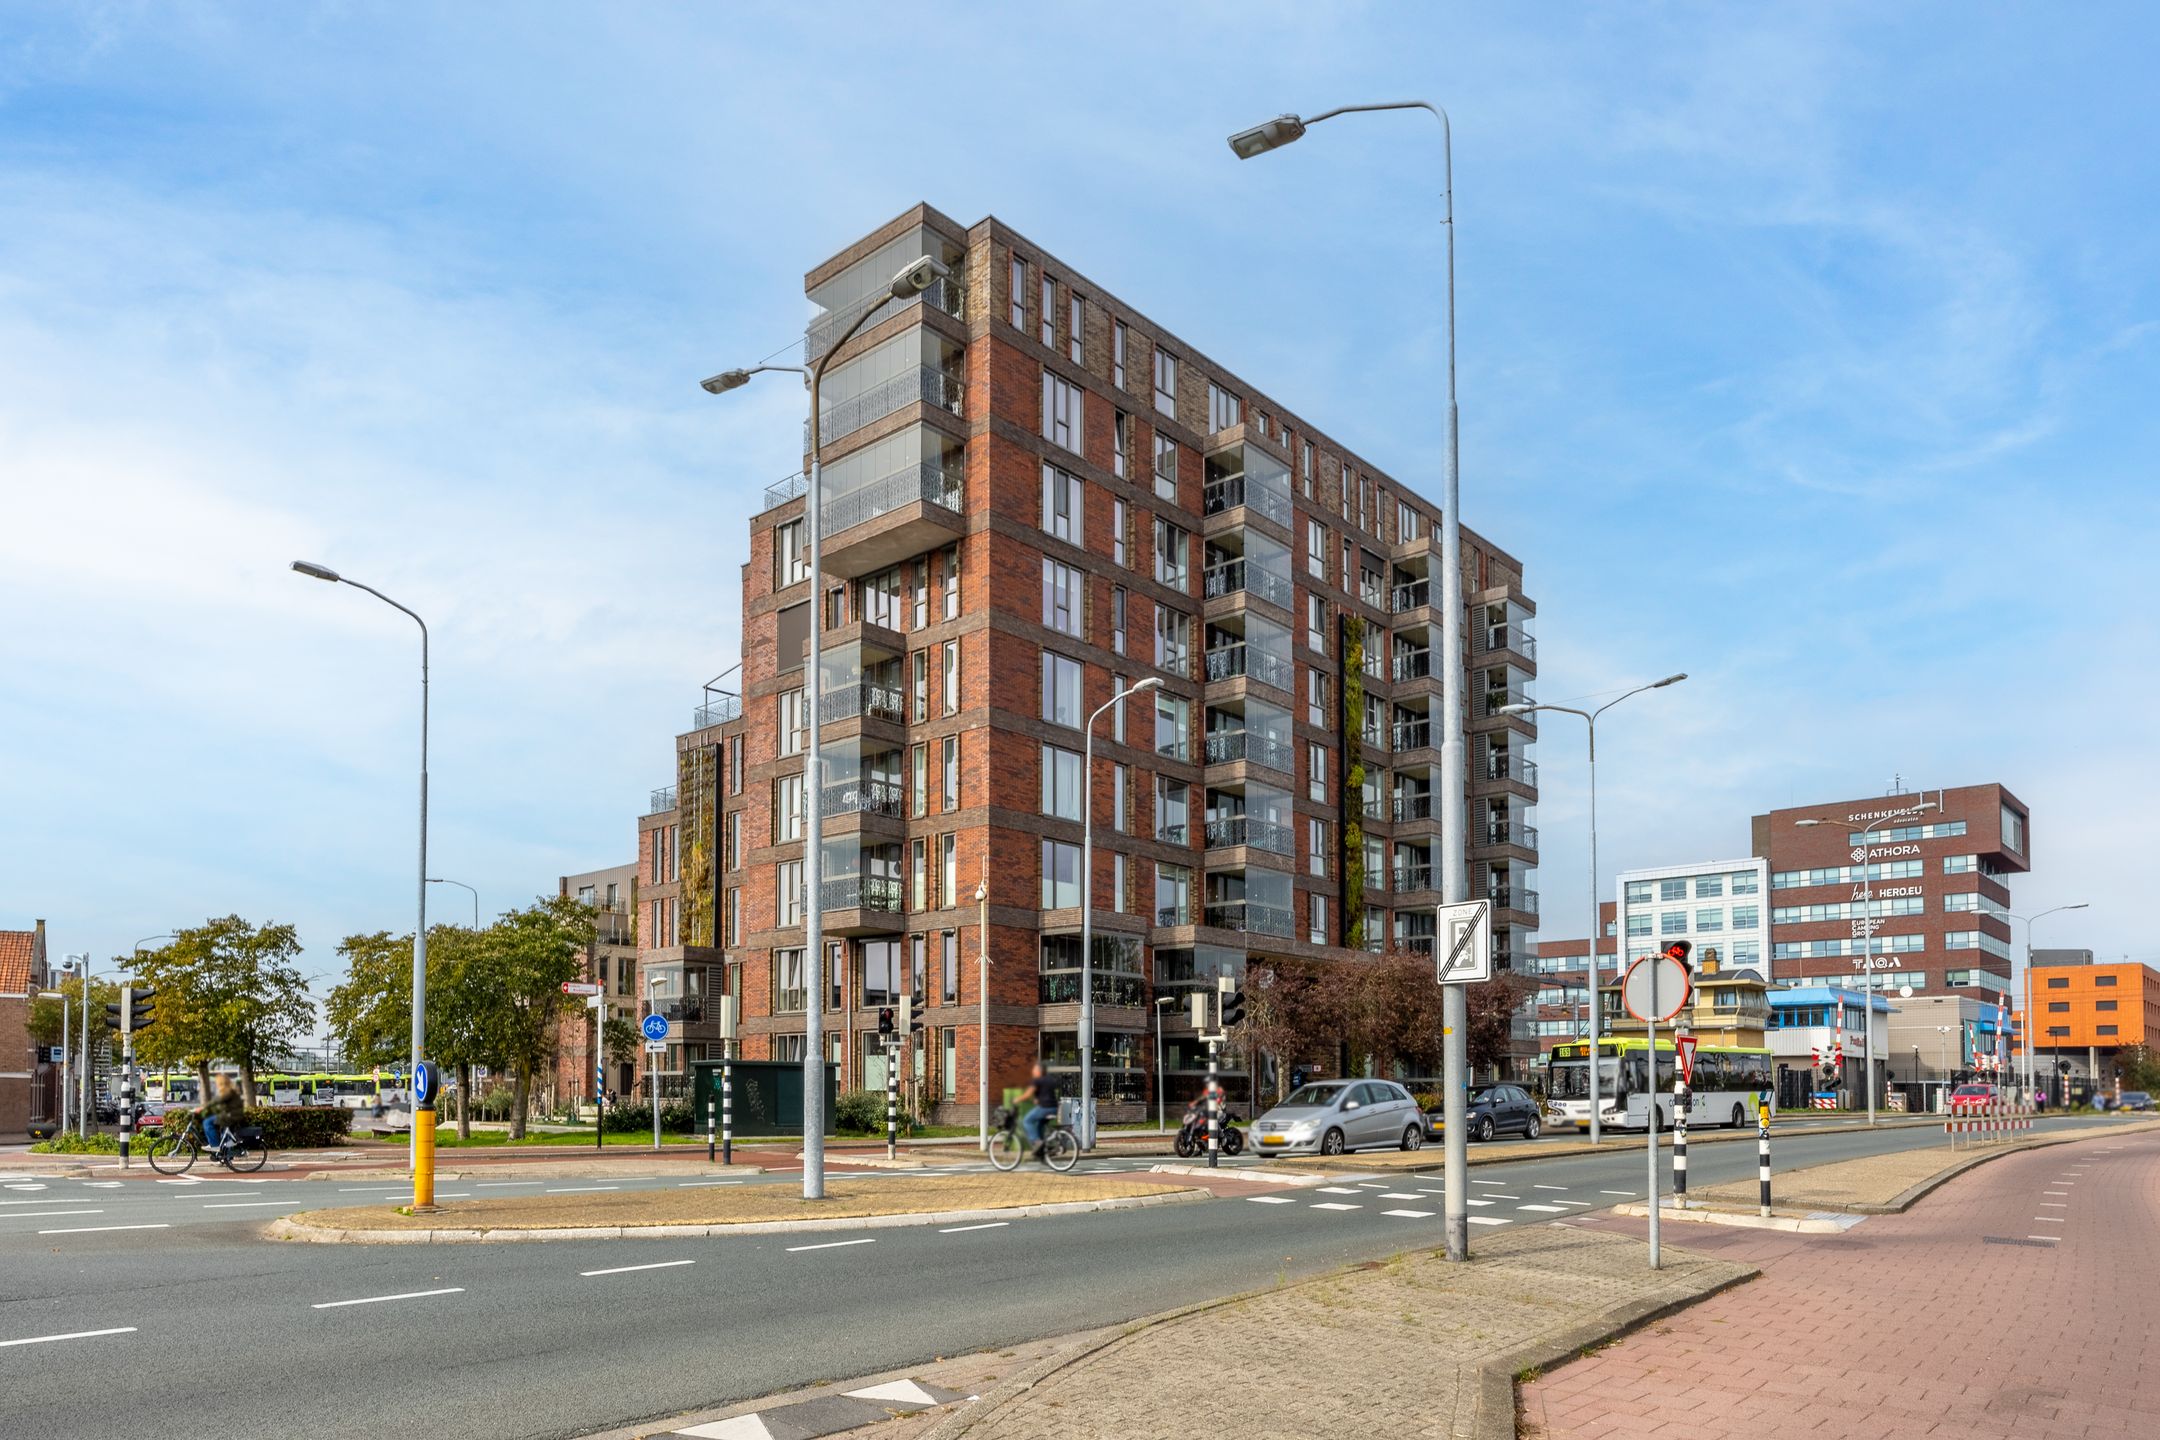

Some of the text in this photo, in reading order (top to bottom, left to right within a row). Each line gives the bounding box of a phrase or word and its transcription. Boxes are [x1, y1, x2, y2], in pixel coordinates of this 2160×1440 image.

[1869, 845, 1921, 858] ATHORA
[1879, 886, 1922, 898] HERO.EU
[1453, 908, 1473, 916] ZONE
[1851, 918, 1886, 926] EURPEAN
[1852, 957, 1901, 969] TAQA
